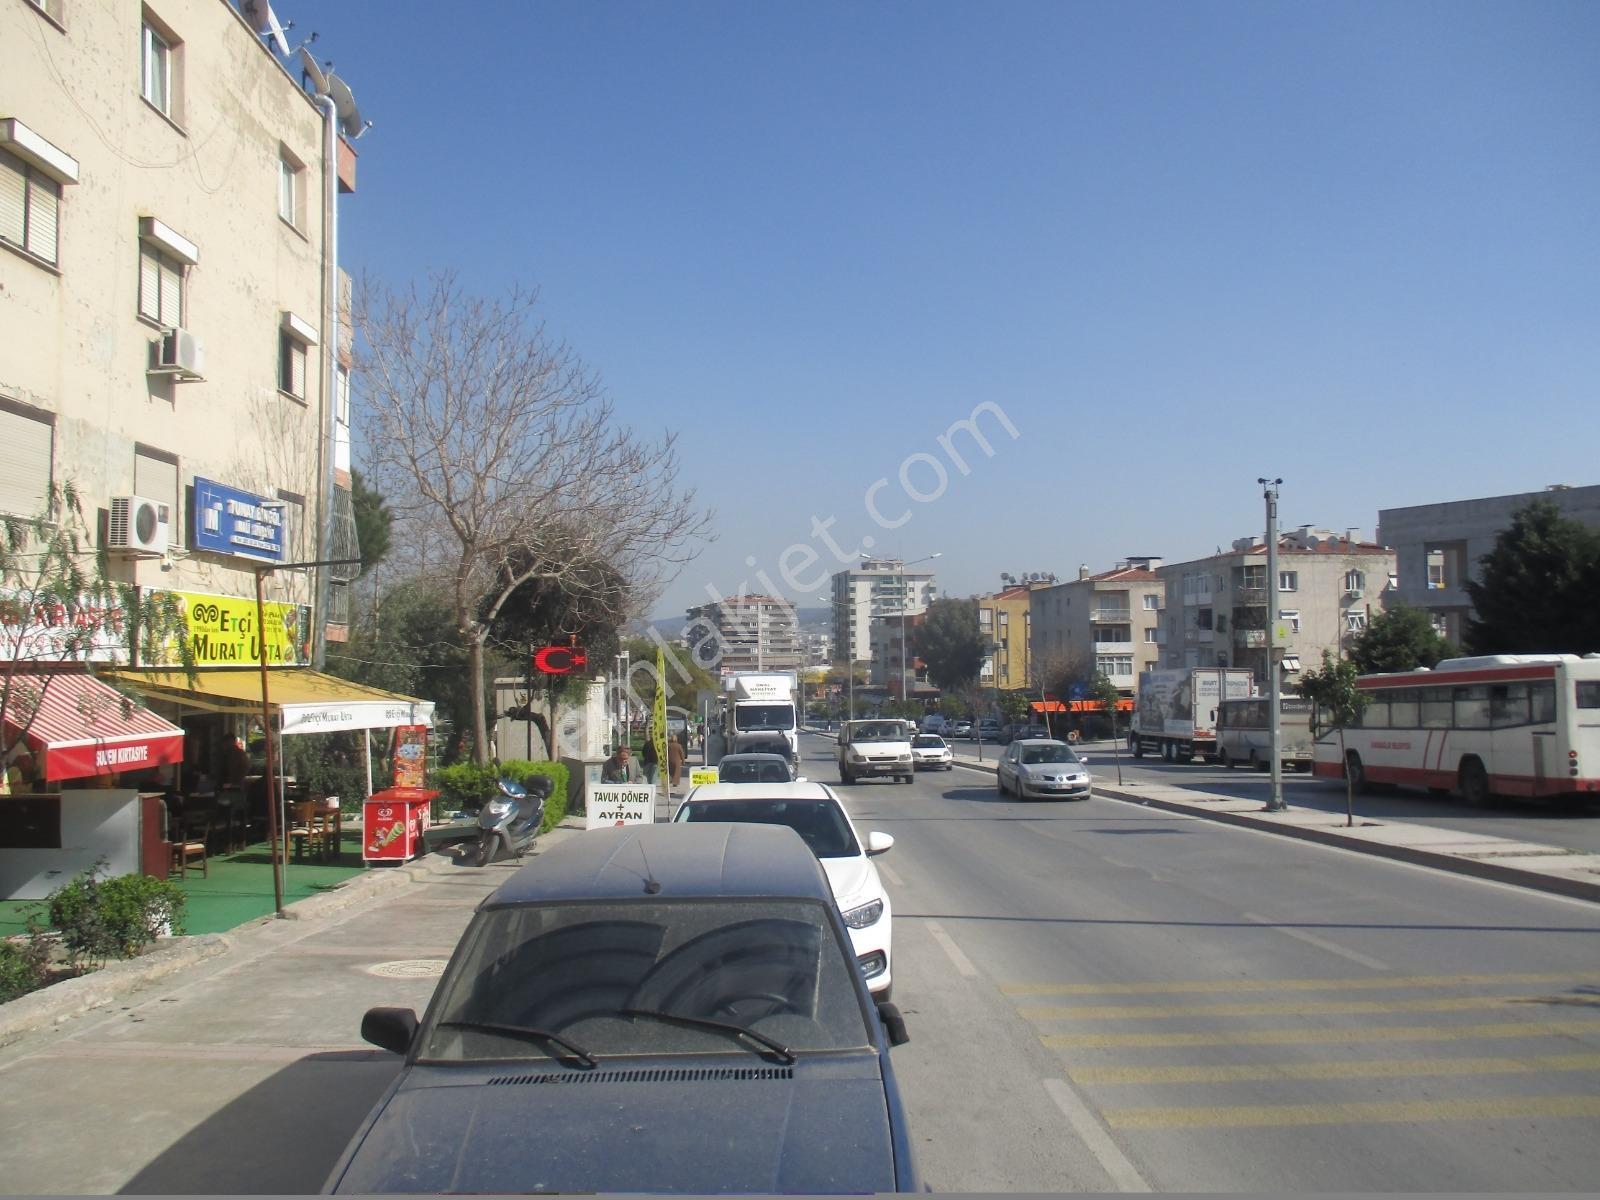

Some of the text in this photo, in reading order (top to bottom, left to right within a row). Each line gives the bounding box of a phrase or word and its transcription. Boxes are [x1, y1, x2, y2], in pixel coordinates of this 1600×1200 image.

[193, 634, 244, 661] MURAT
[594, 792, 620, 803] TAVUK
[599, 811, 642, 820] AYRAN
